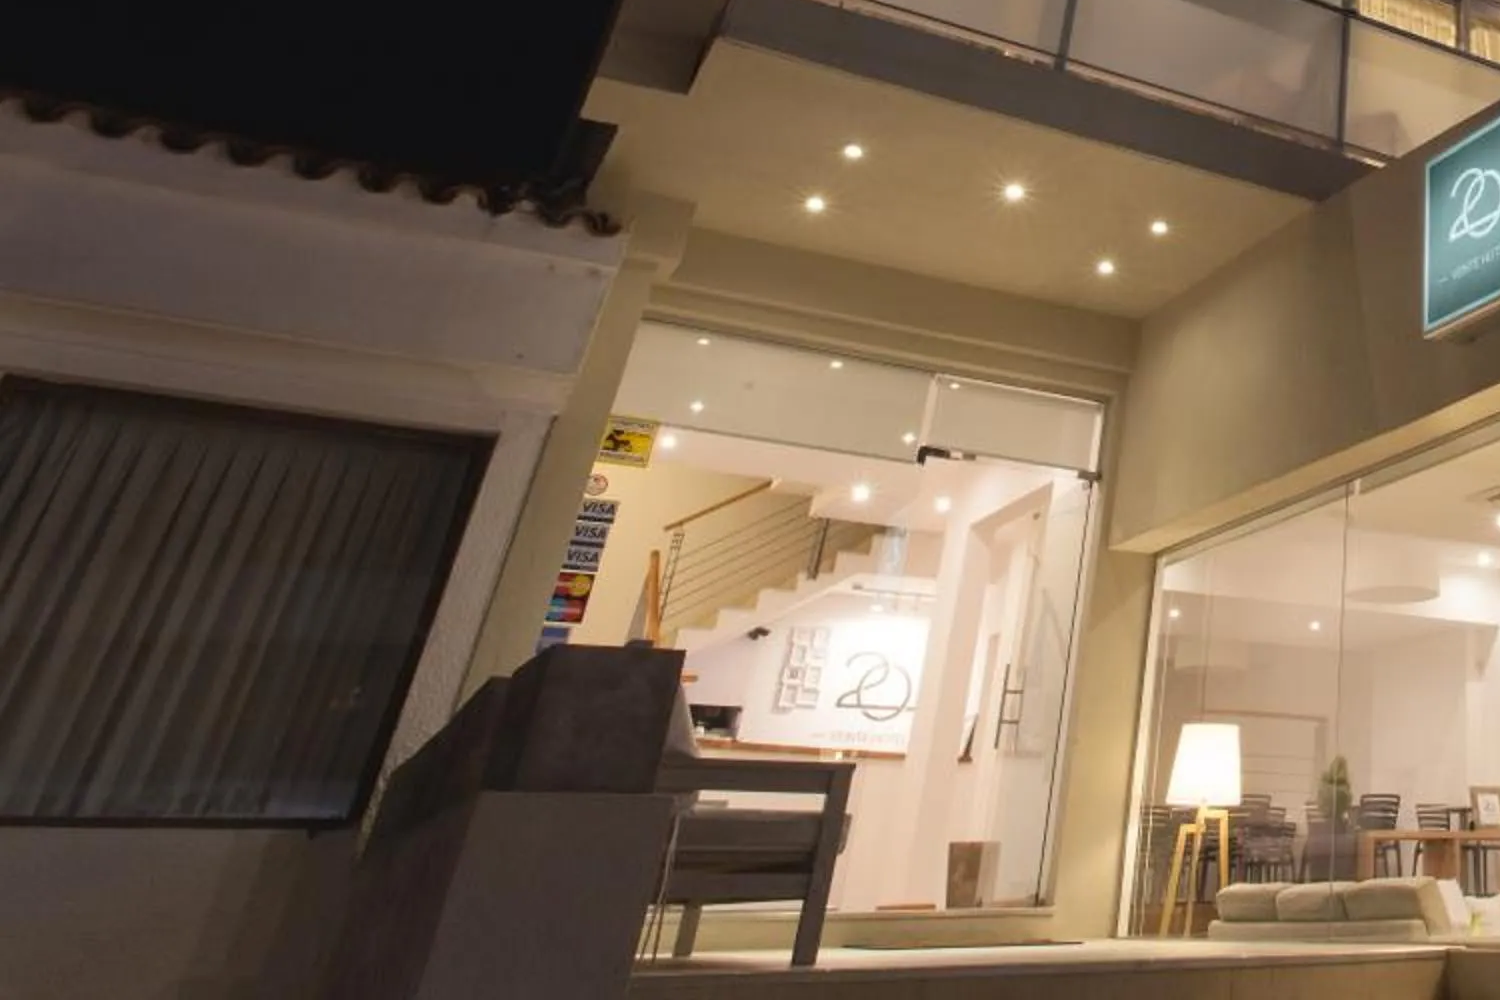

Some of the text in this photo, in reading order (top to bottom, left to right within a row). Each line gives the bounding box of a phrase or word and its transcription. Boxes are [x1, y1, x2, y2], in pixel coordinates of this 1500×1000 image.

[583, 501, 615, 515] VISA
[575, 525, 606, 539] VISA
[567, 548, 599, 562] VISA
